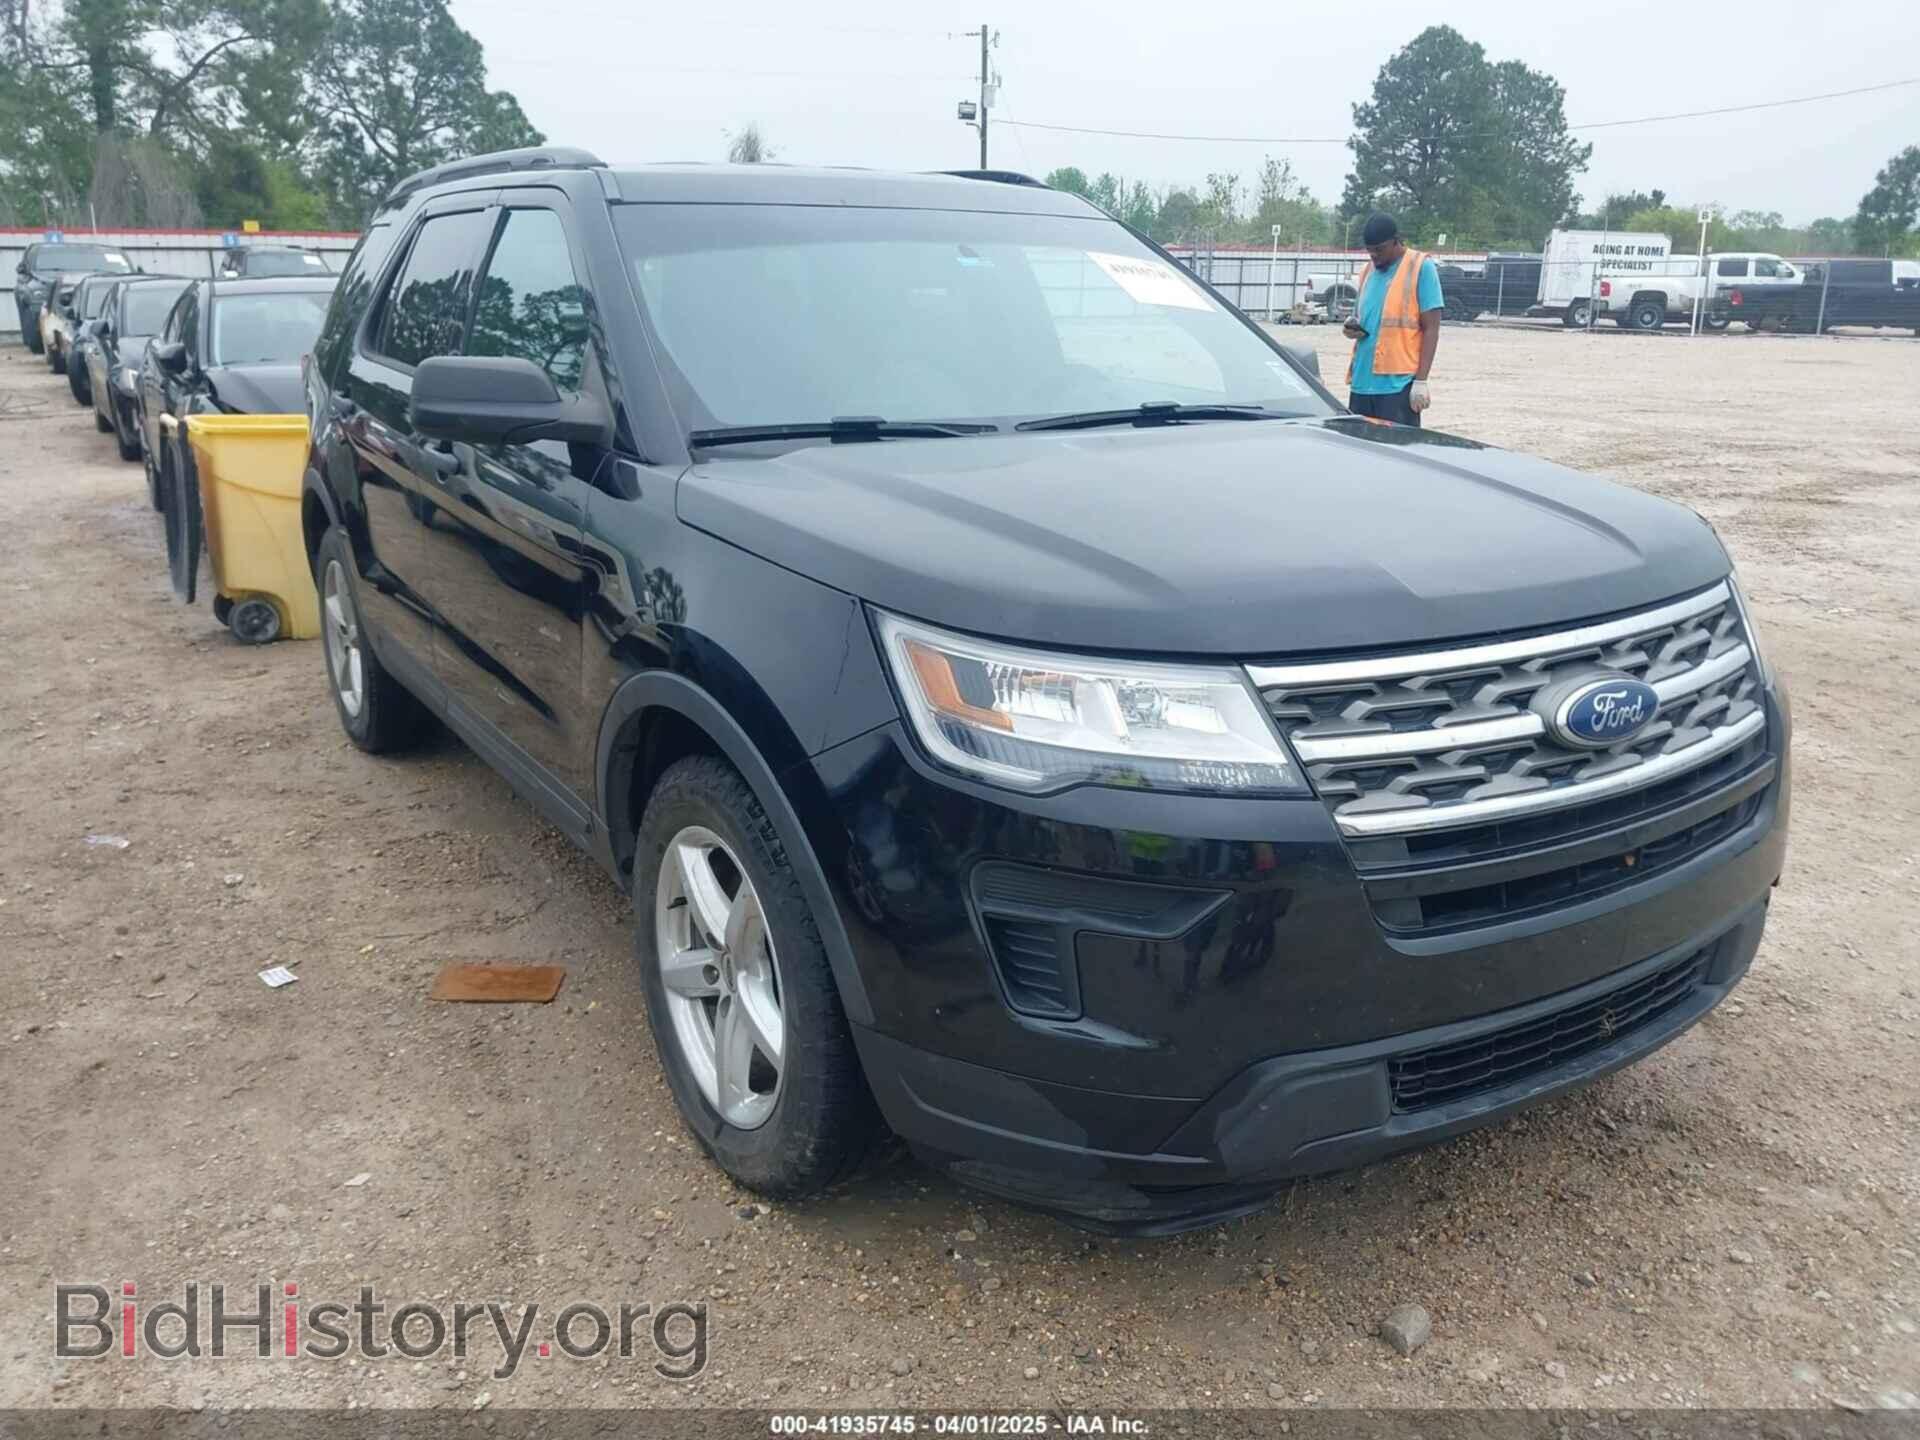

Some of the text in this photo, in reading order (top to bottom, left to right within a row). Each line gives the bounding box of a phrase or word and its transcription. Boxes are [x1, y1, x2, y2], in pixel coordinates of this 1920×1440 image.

[1592, 244, 1664, 257] AGING AT HOME
[1600, 259, 1653, 270] SPECIALIST
[1591, 690, 1645, 732] Ford
